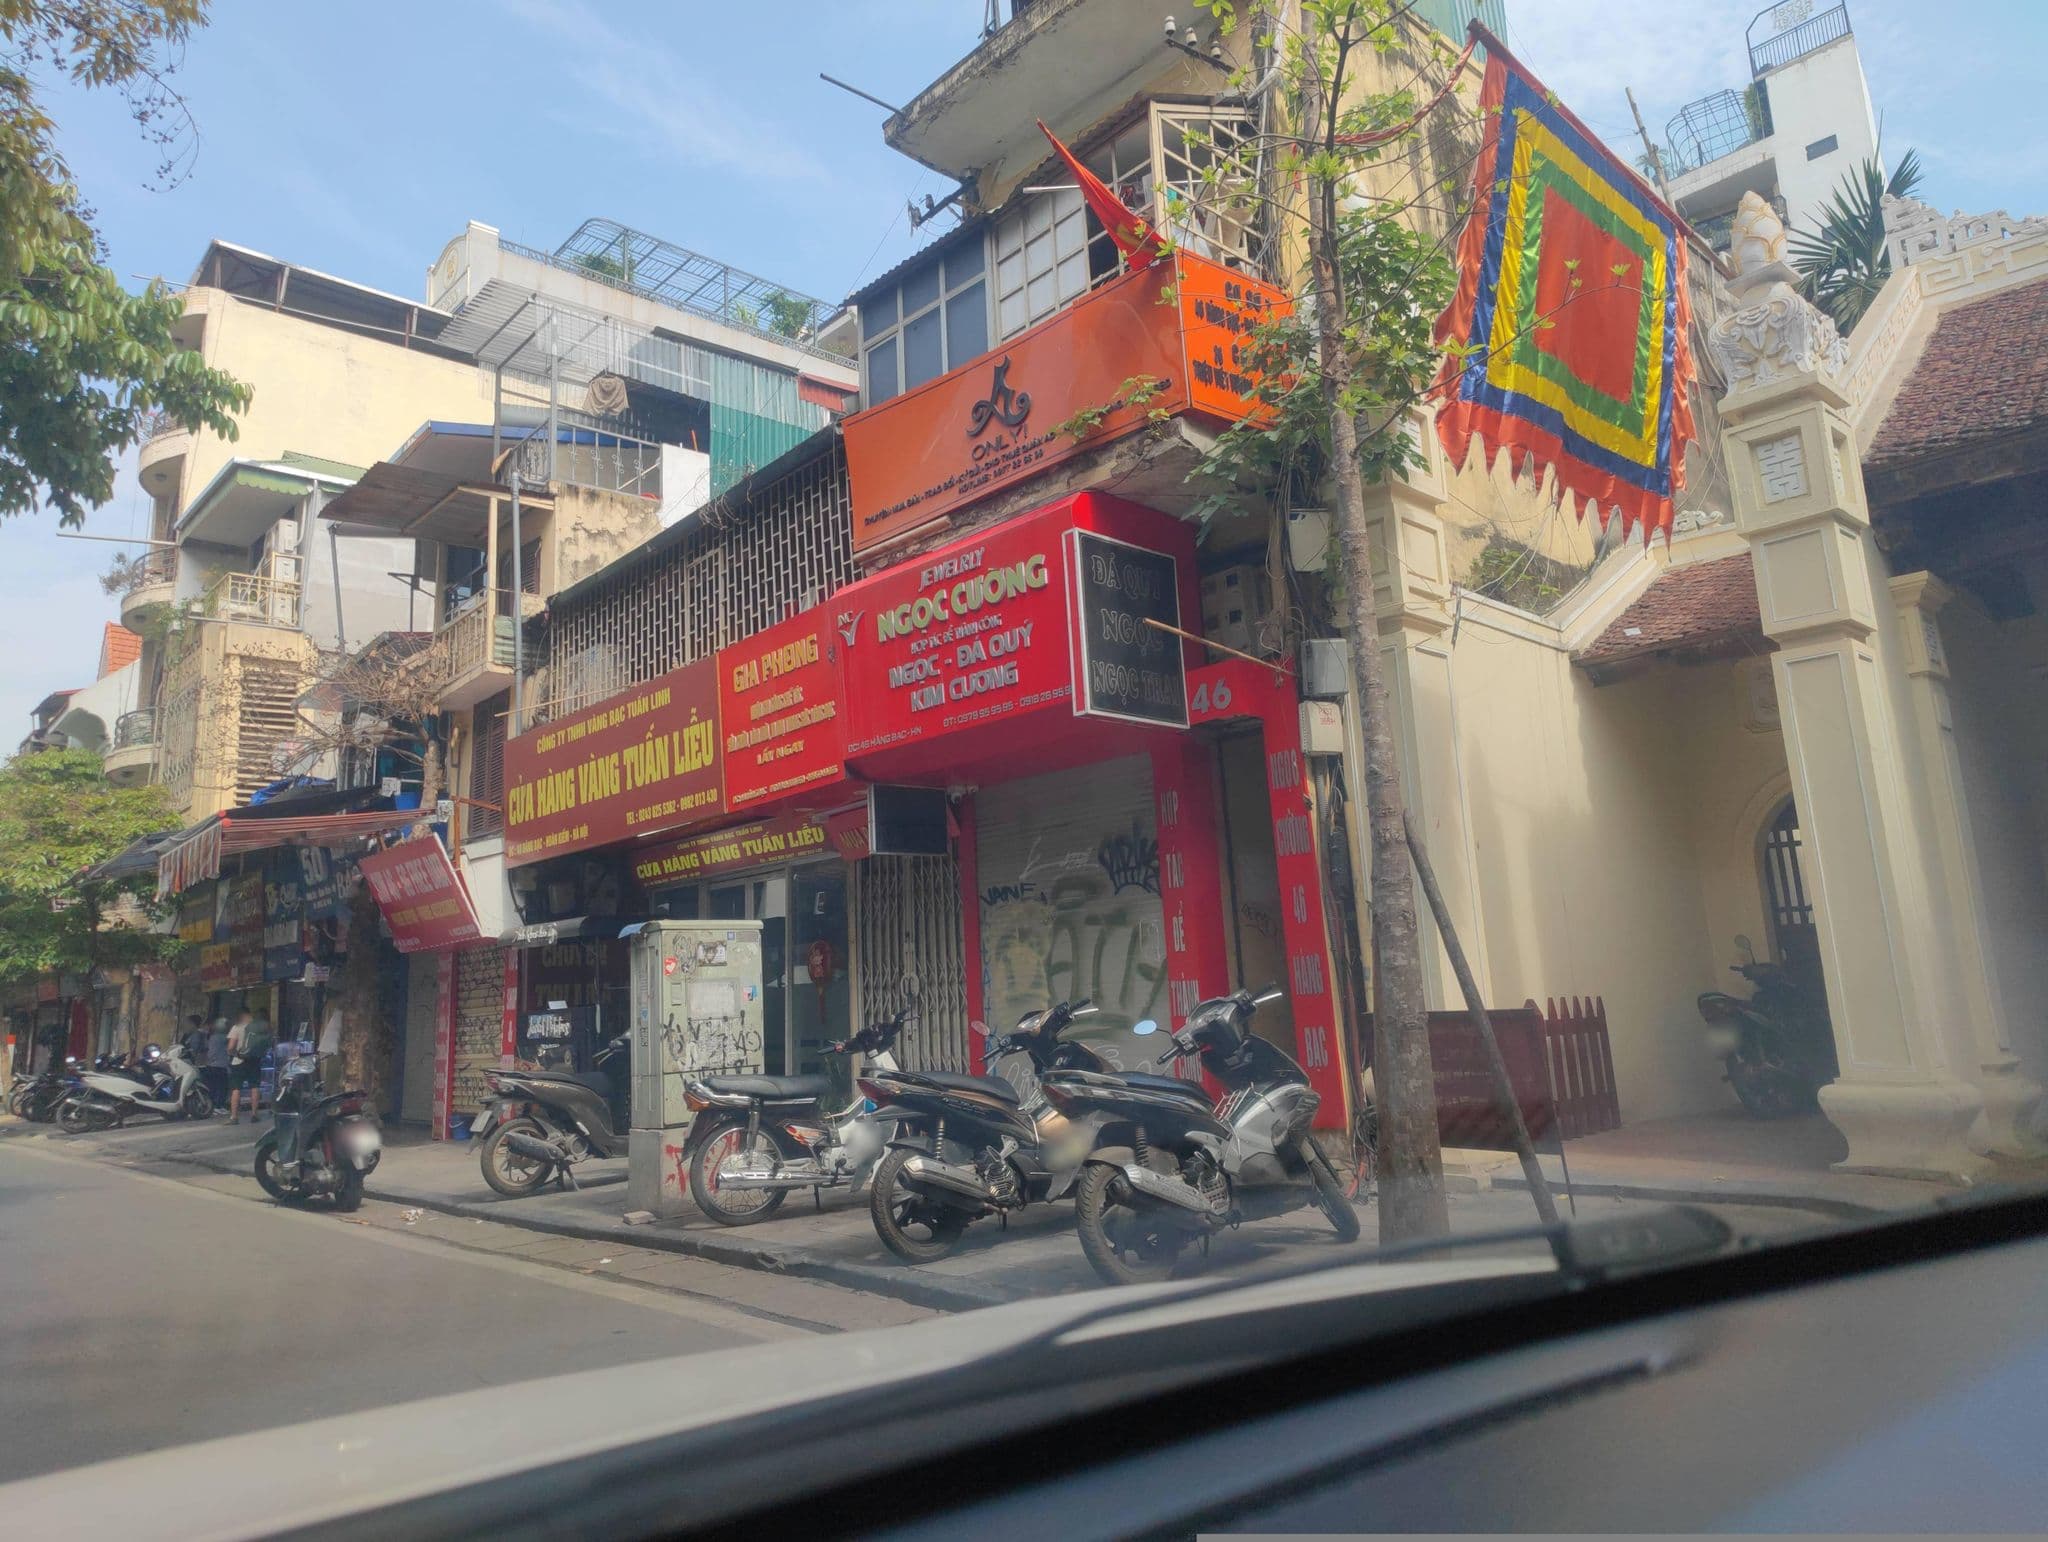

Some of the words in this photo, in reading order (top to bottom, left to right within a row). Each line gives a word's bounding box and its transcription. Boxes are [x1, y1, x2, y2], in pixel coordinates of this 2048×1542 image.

[1091, 552, 1121, 590] ĐÁ
[877, 589, 949, 643] NGỌC
[733, 660, 760, 694] GIA
[761, 633, 819, 682] PHONG
[888, 654, 941, 688] NGỌC
[957, 635, 987, 669] ĐÁ
[1092, 660, 1139, 705] NGỌC
[911, 683, 946, 713] KIM
[1192, 678, 1232, 714] 46
[536, 735, 556, 754] CÔNG
[557, 732, 565, 746] TY
[566, 726, 586, 743] TNHH
[587, 713, 608, 734] VÀNG
[609, 708, 626, 728] BẠC
[650, 687, 671, 709] LINH
[508, 774, 534, 826] CỬA
[536, 767, 576, 819] HÀNG
[578, 753, 621, 804] VÀNG
[623, 722, 670, 791] TUẤN
[673, 706, 714, 776] LIỄU
[636, 860, 662, 880] CỬA
[663, 854, 699, 875] HÀNG
[701, 844, 742, 866] VÀNG
[742, 831, 786, 857] TUẤN
[788, 823, 825, 848] LIỄU
[1166, 847, 1185, 890] TÁC
[1292, 884, 1307, 924] 46
[1292, 949, 1324, 996] HÀNG
[1304, 1026, 1329, 1072] BẠC
